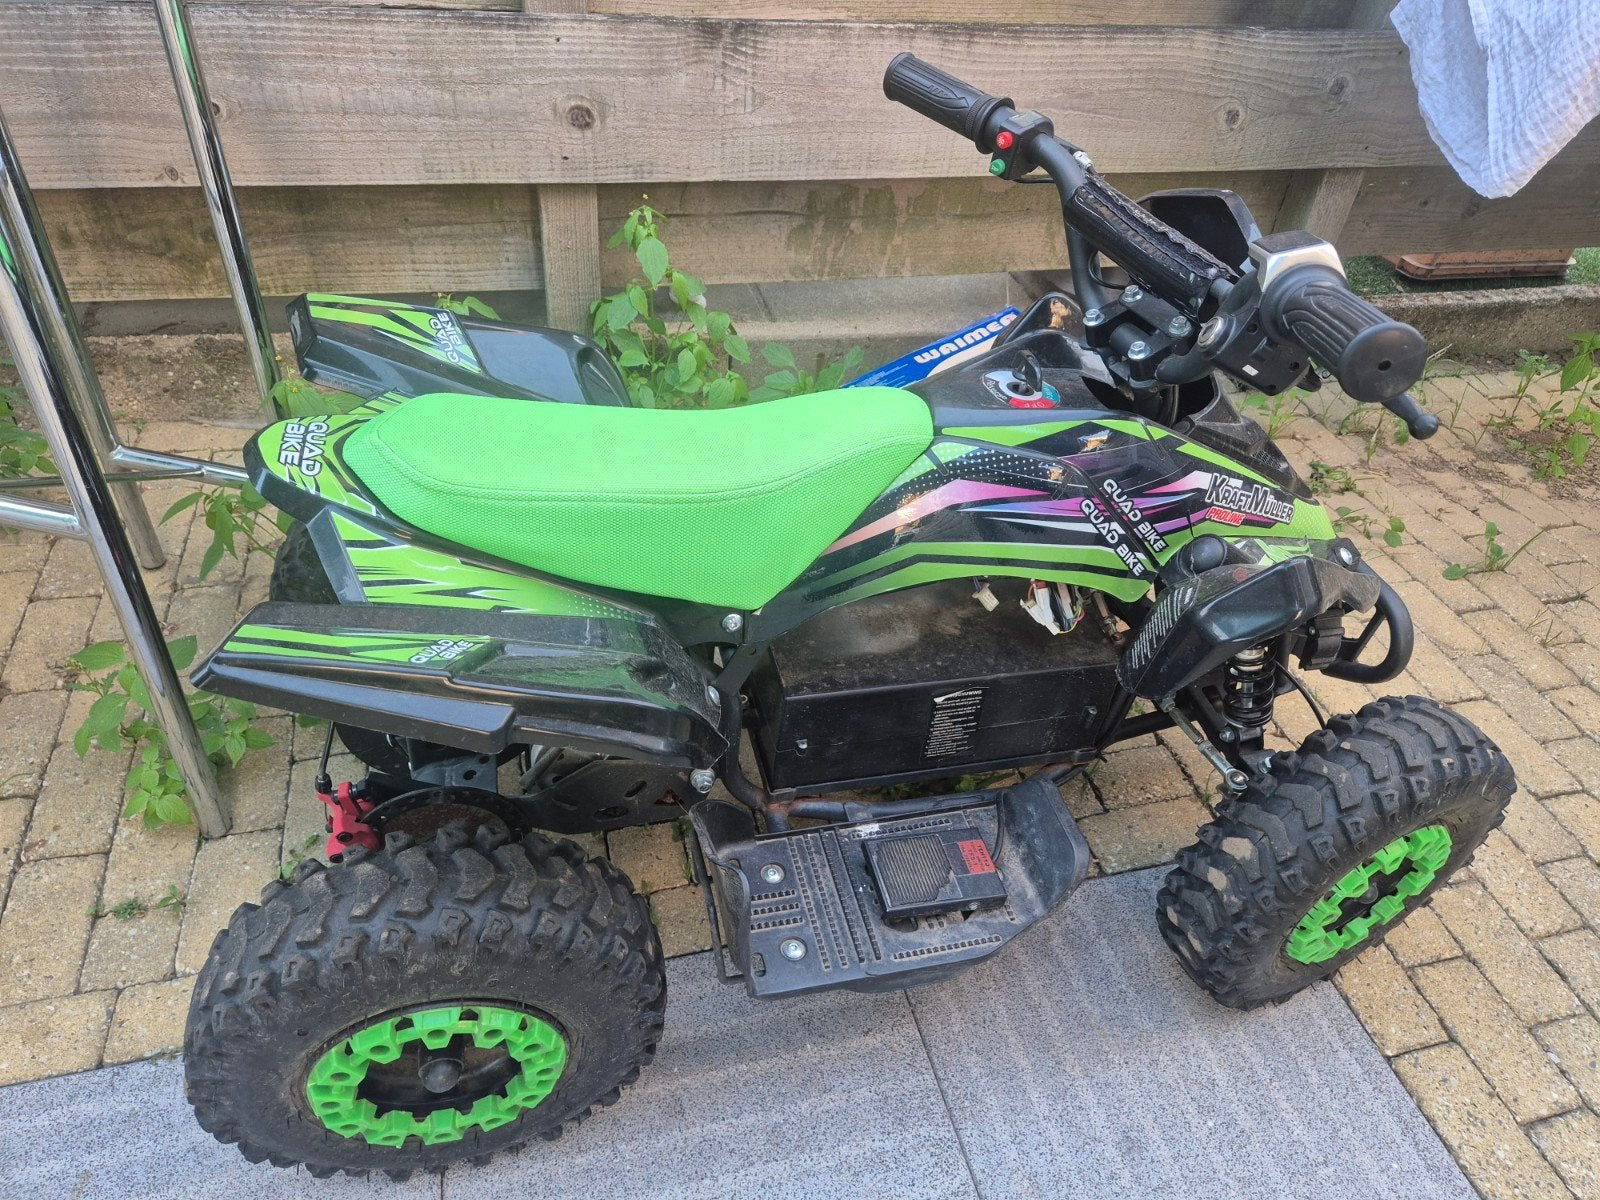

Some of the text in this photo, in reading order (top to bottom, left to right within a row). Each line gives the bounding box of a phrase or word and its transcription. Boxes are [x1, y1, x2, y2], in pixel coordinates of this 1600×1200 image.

[430, 318, 459, 363] QUAD
[437, 312, 462, 345] BIKE
[279, 423, 305, 465] BIKE
[300, 421, 329, 477] QUAD
[1103, 478, 1142, 522] QUAD
[1137, 520, 1167, 552] BIKE
[1206, 506, 1246, 526] PROLINE
[1080, 499, 1145, 577] QUAD BIKE
[410, 639, 454, 664] QUAD
[438, 639, 474, 660] BIKE
